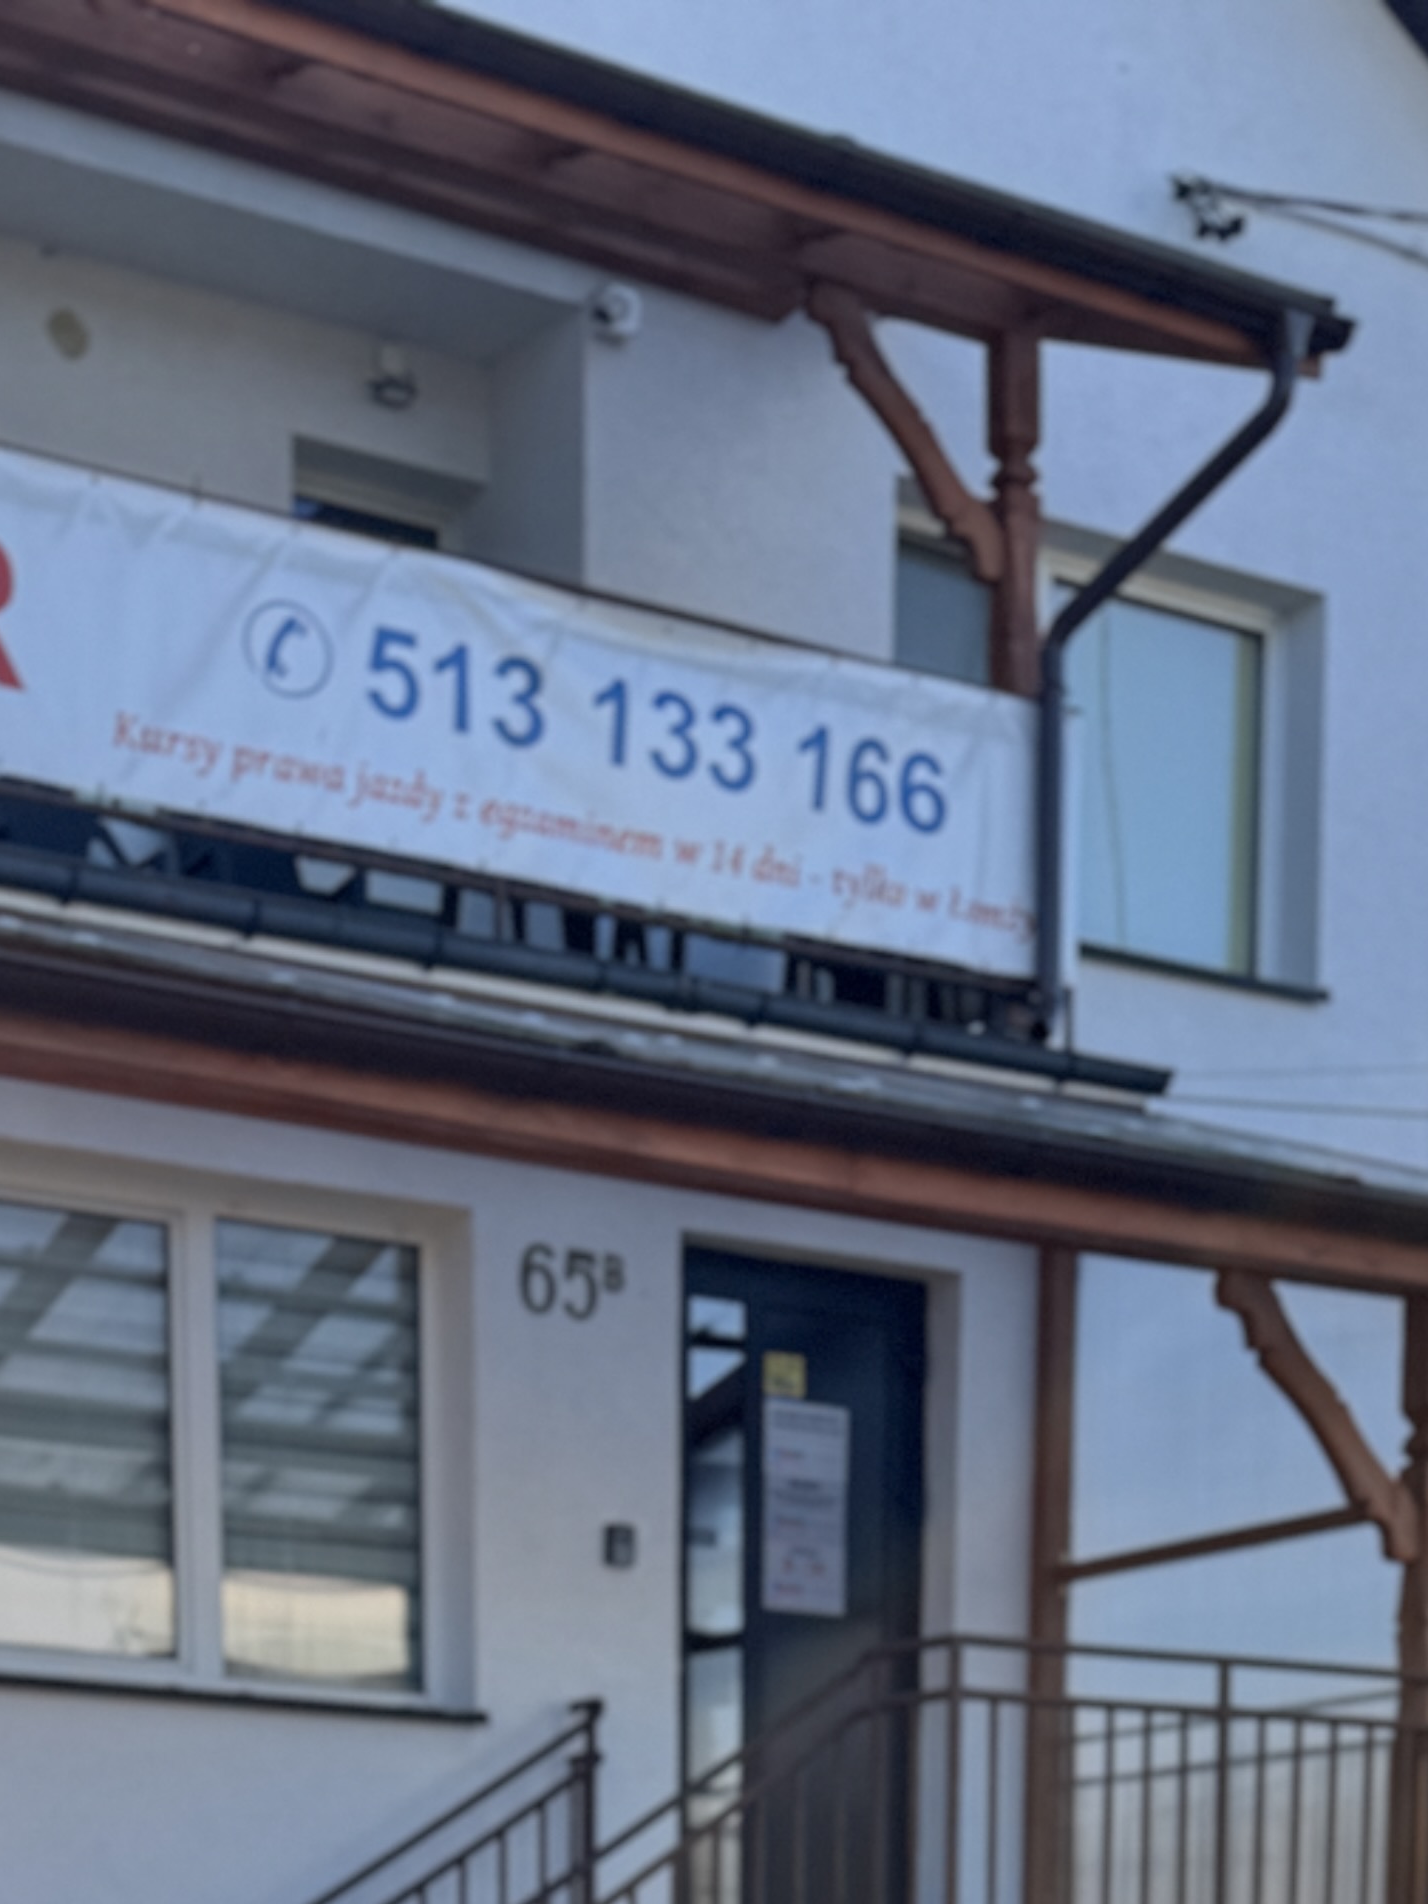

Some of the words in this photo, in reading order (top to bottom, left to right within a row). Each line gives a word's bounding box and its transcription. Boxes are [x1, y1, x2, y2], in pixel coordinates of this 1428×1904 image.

[112, 711, 221, 776] Kursy
[232, 743, 345, 791] prawa
[348, 761, 443, 821] jazdy
[479, 794, 663, 859] egzaminem
[673, 838, 703, 866] w
[710, 840, 746, 878] 14
[751, 842, 802, 888] dni
[831, 861, 905, 910] tylko
[913, 888, 943, 912] w
[367, 626, 545, 748] 513
[593, 677, 756, 792] 133
[797, 724, 947, 835] 166
